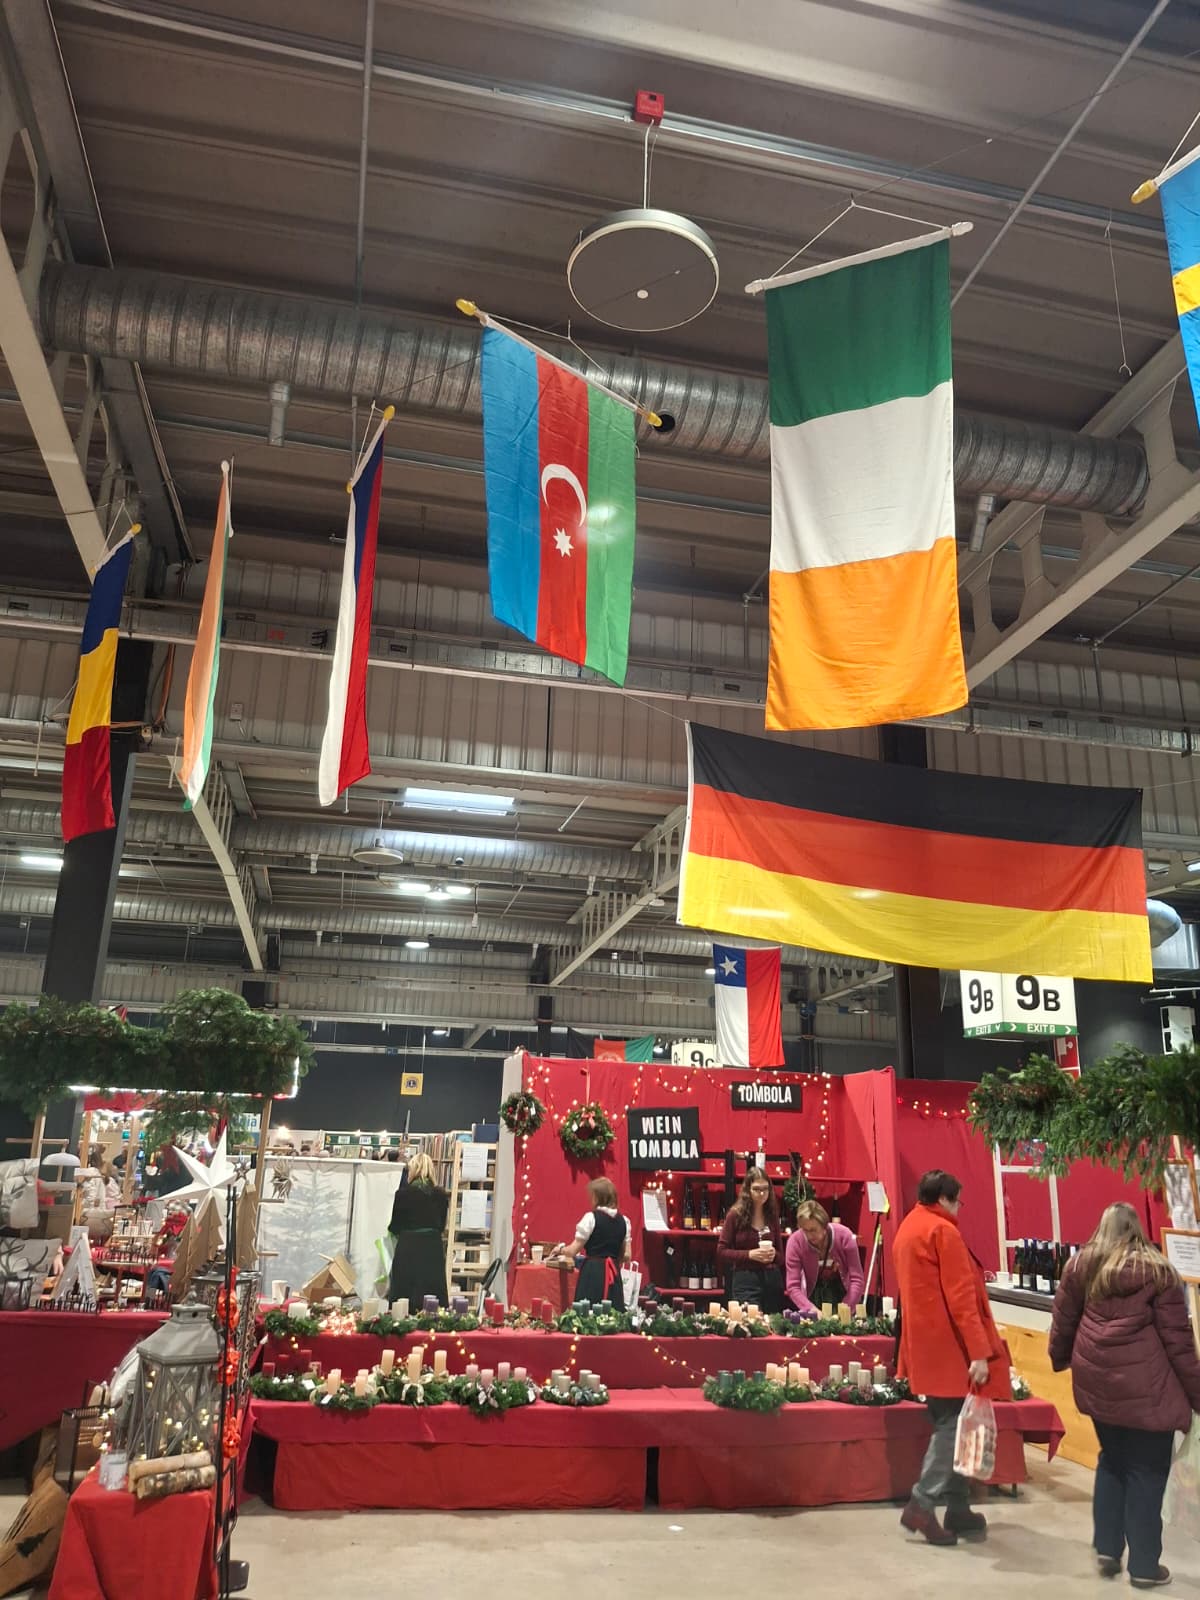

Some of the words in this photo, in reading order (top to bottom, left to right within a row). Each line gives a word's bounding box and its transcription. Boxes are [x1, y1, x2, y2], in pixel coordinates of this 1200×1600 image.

[969, 978, 994, 1014] 9B
[1016, 975, 1060, 1011] 9B
[1027, 1024, 1048, 1033] EXIT
[739, 1085, 793, 1104] TOMBOLA
[641, 1115, 682, 1135] WEIN
[630, 1139, 699, 1159] TOMBOLA
